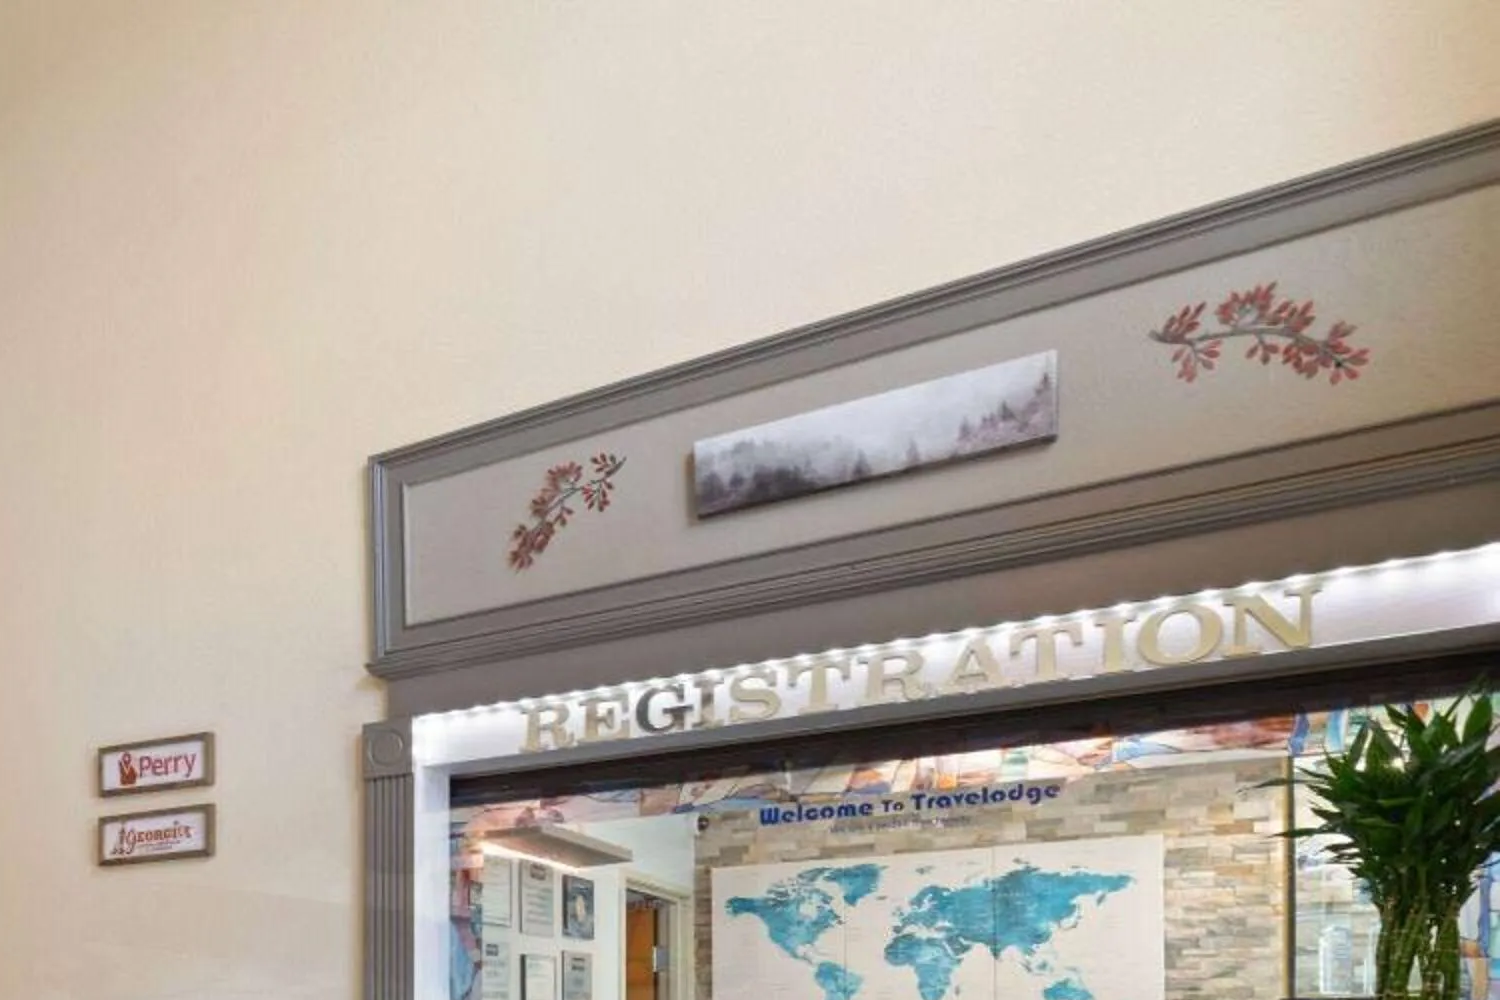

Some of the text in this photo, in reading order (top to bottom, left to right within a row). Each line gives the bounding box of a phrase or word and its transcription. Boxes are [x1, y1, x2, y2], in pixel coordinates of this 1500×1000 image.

[519, 587, 1324, 753] REGISTRATION
[139, 752, 197, 778] Perry
[759, 802, 874, 826] Welcome
[882, 799, 905, 814] To
[911, 783, 1063, 812] Travelodge
